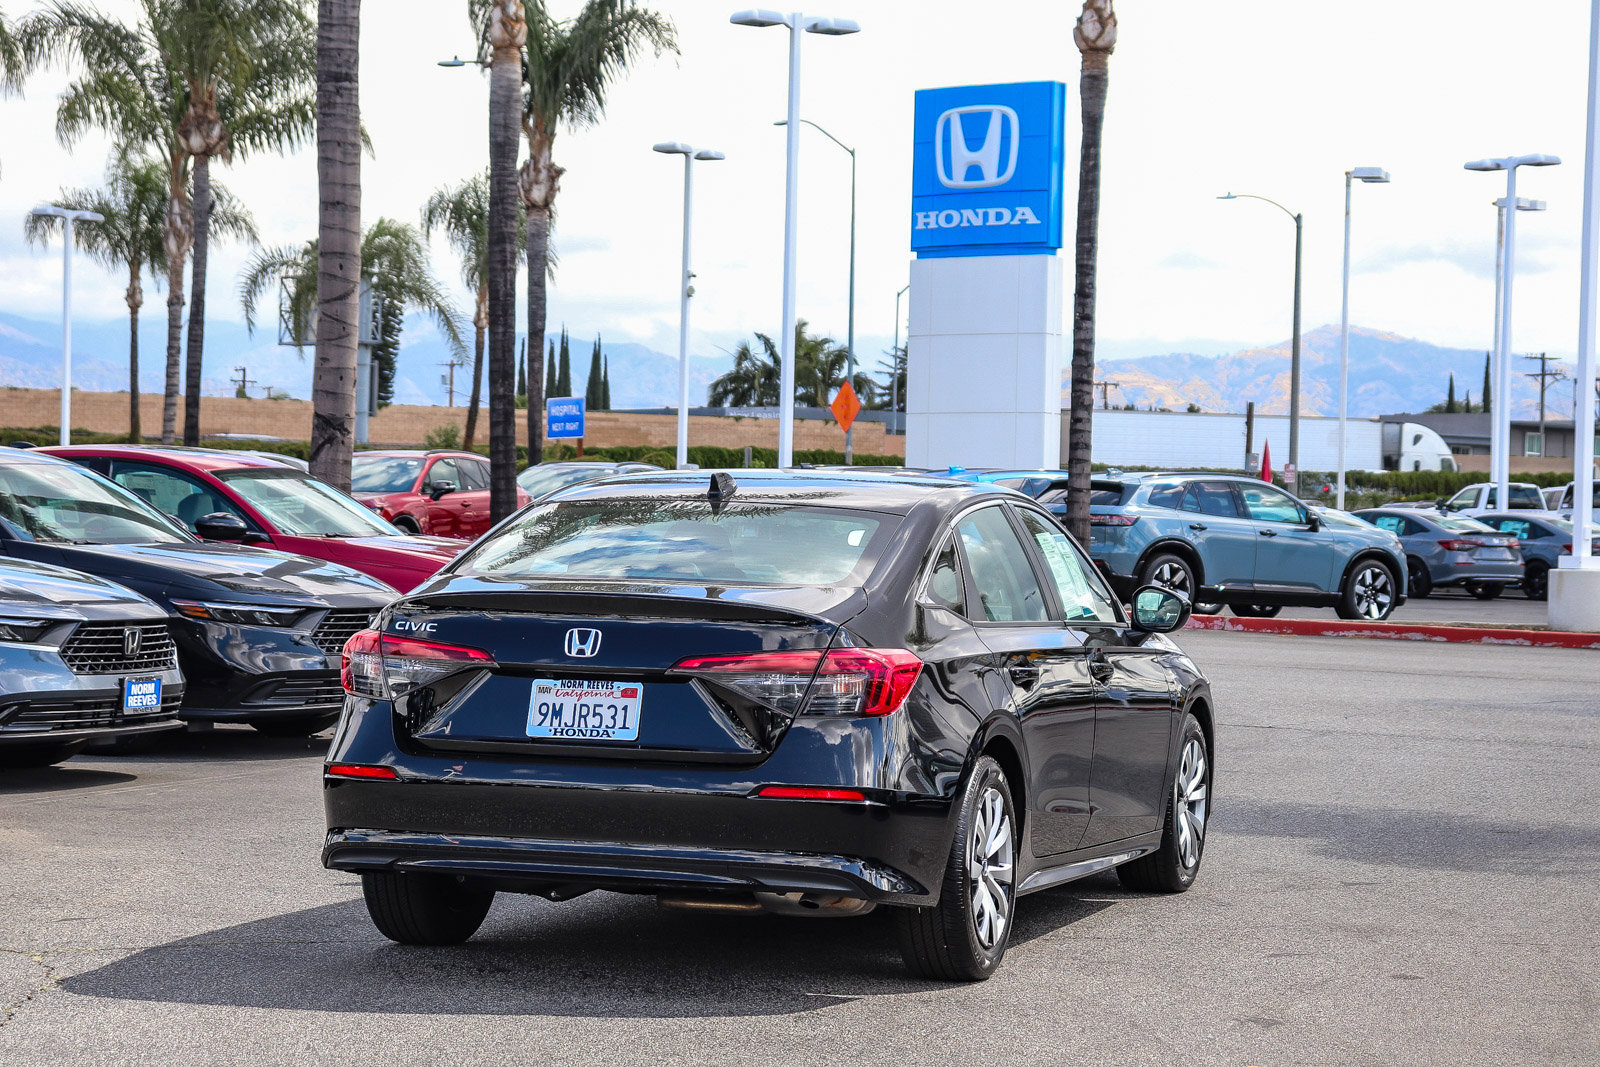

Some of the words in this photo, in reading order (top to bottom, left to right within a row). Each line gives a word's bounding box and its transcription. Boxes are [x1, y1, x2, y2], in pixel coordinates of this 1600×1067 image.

[915, 206, 1041, 230] HONDA
[551, 404, 580, 416] HOSPITAL
[552, 422, 564, 431] NEXT
[565, 421, 579, 431] RIGHT
[395, 620, 438, 632] CIVIC
[131, 682, 155, 695] NORM
[538, 686, 552, 694] MAY
[560, 679, 584, 689] NORM
[586, 680, 615, 690] REEVES
[128, 694, 157, 707] REEVES
[555, 689, 620, 702] California
[537, 702, 630, 730] 9MJR531
[552, 727, 612, 738] HONDA
